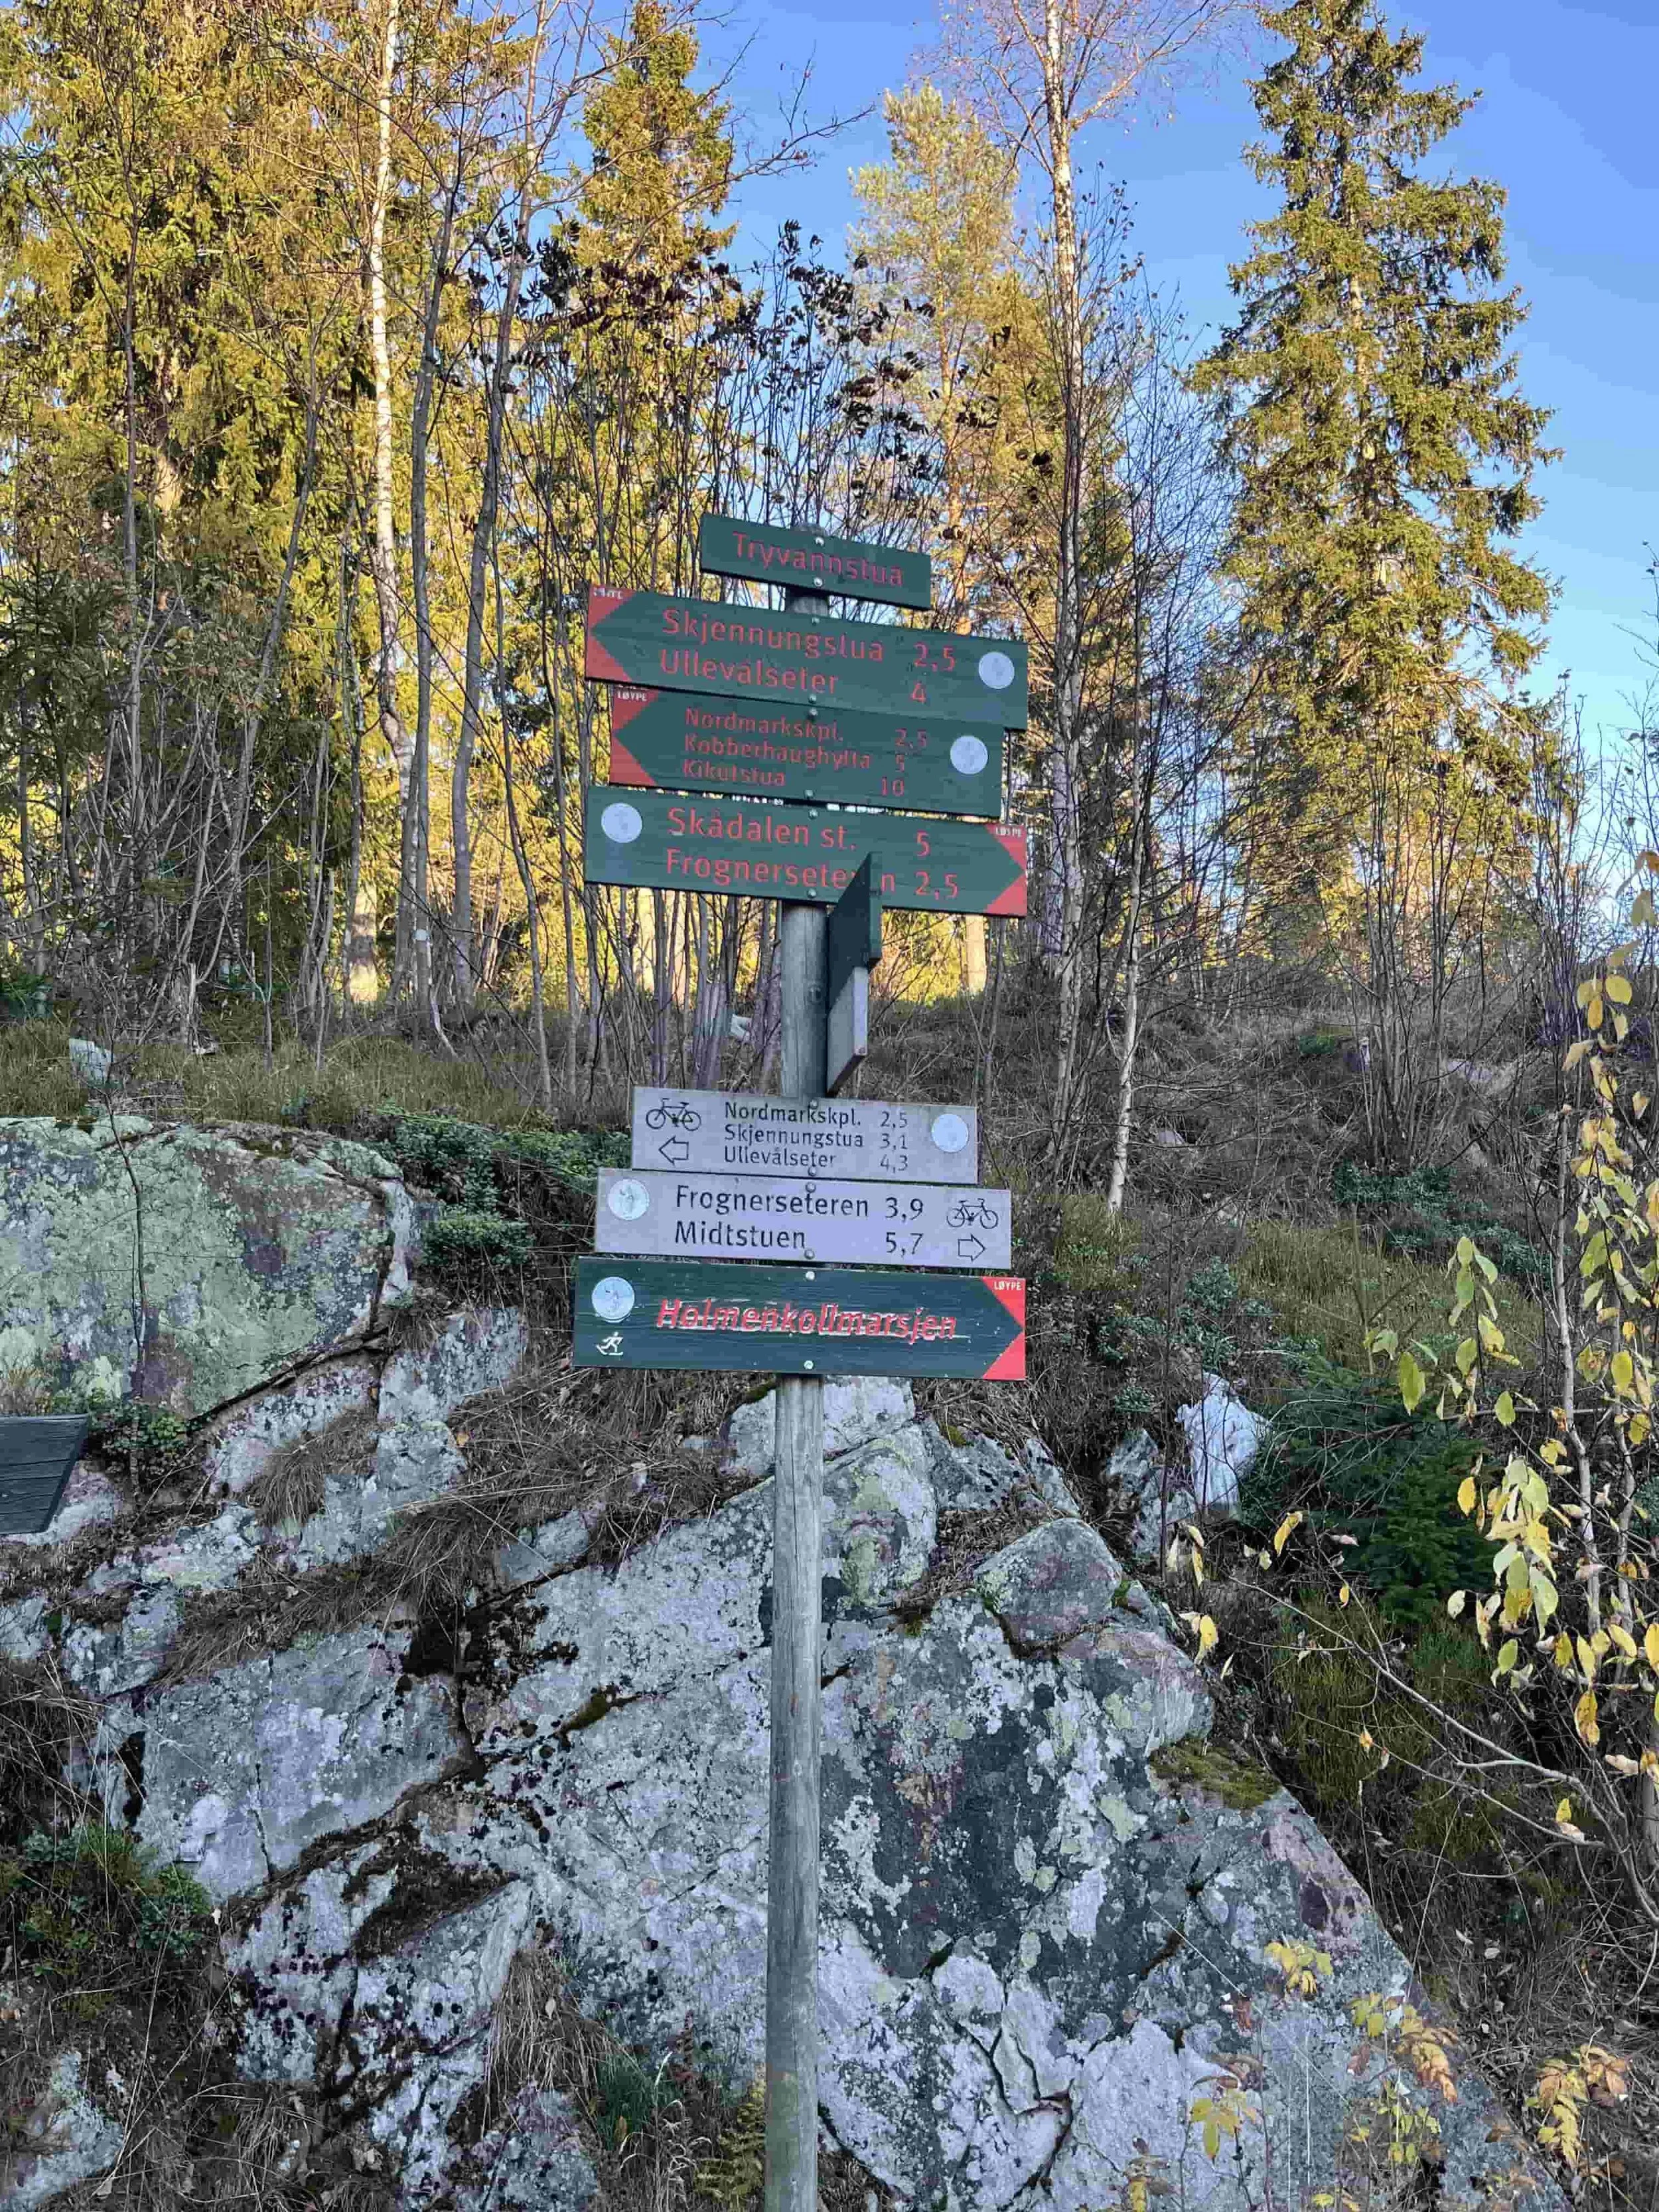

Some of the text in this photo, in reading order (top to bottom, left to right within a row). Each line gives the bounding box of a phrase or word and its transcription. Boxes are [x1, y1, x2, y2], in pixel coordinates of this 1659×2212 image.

[733, 532, 904, 587] Tryvannstua
[662, 607, 957, 673] Skjennungstua 2,5
[910, 684, 926, 704] 4
[684, 707, 844, 742] Nordmarkskpl.
[682, 759, 904, 796] Kikutstua 10
[667, 806, 931, 857] Skådalen st. 5
[666, 848, 959, 900] Frognerseten 2,5
[724, 1101, 908, 1128] Nordmarkskpl. 2,5
[724, 1124, 908, 1151] Skjennungstua 3,1
[724, 1145, 908, 1173] Ullevålseter 4,3
[676, 1184, 924, 1222] Frognerseteren 3,9
[674, 1220, 924, 1256] Midtstuen 5,7
[993, 1280, 1022, 1291] LØYPE
[656, 1297, 957, 1345] Holmenkollmarsjen
